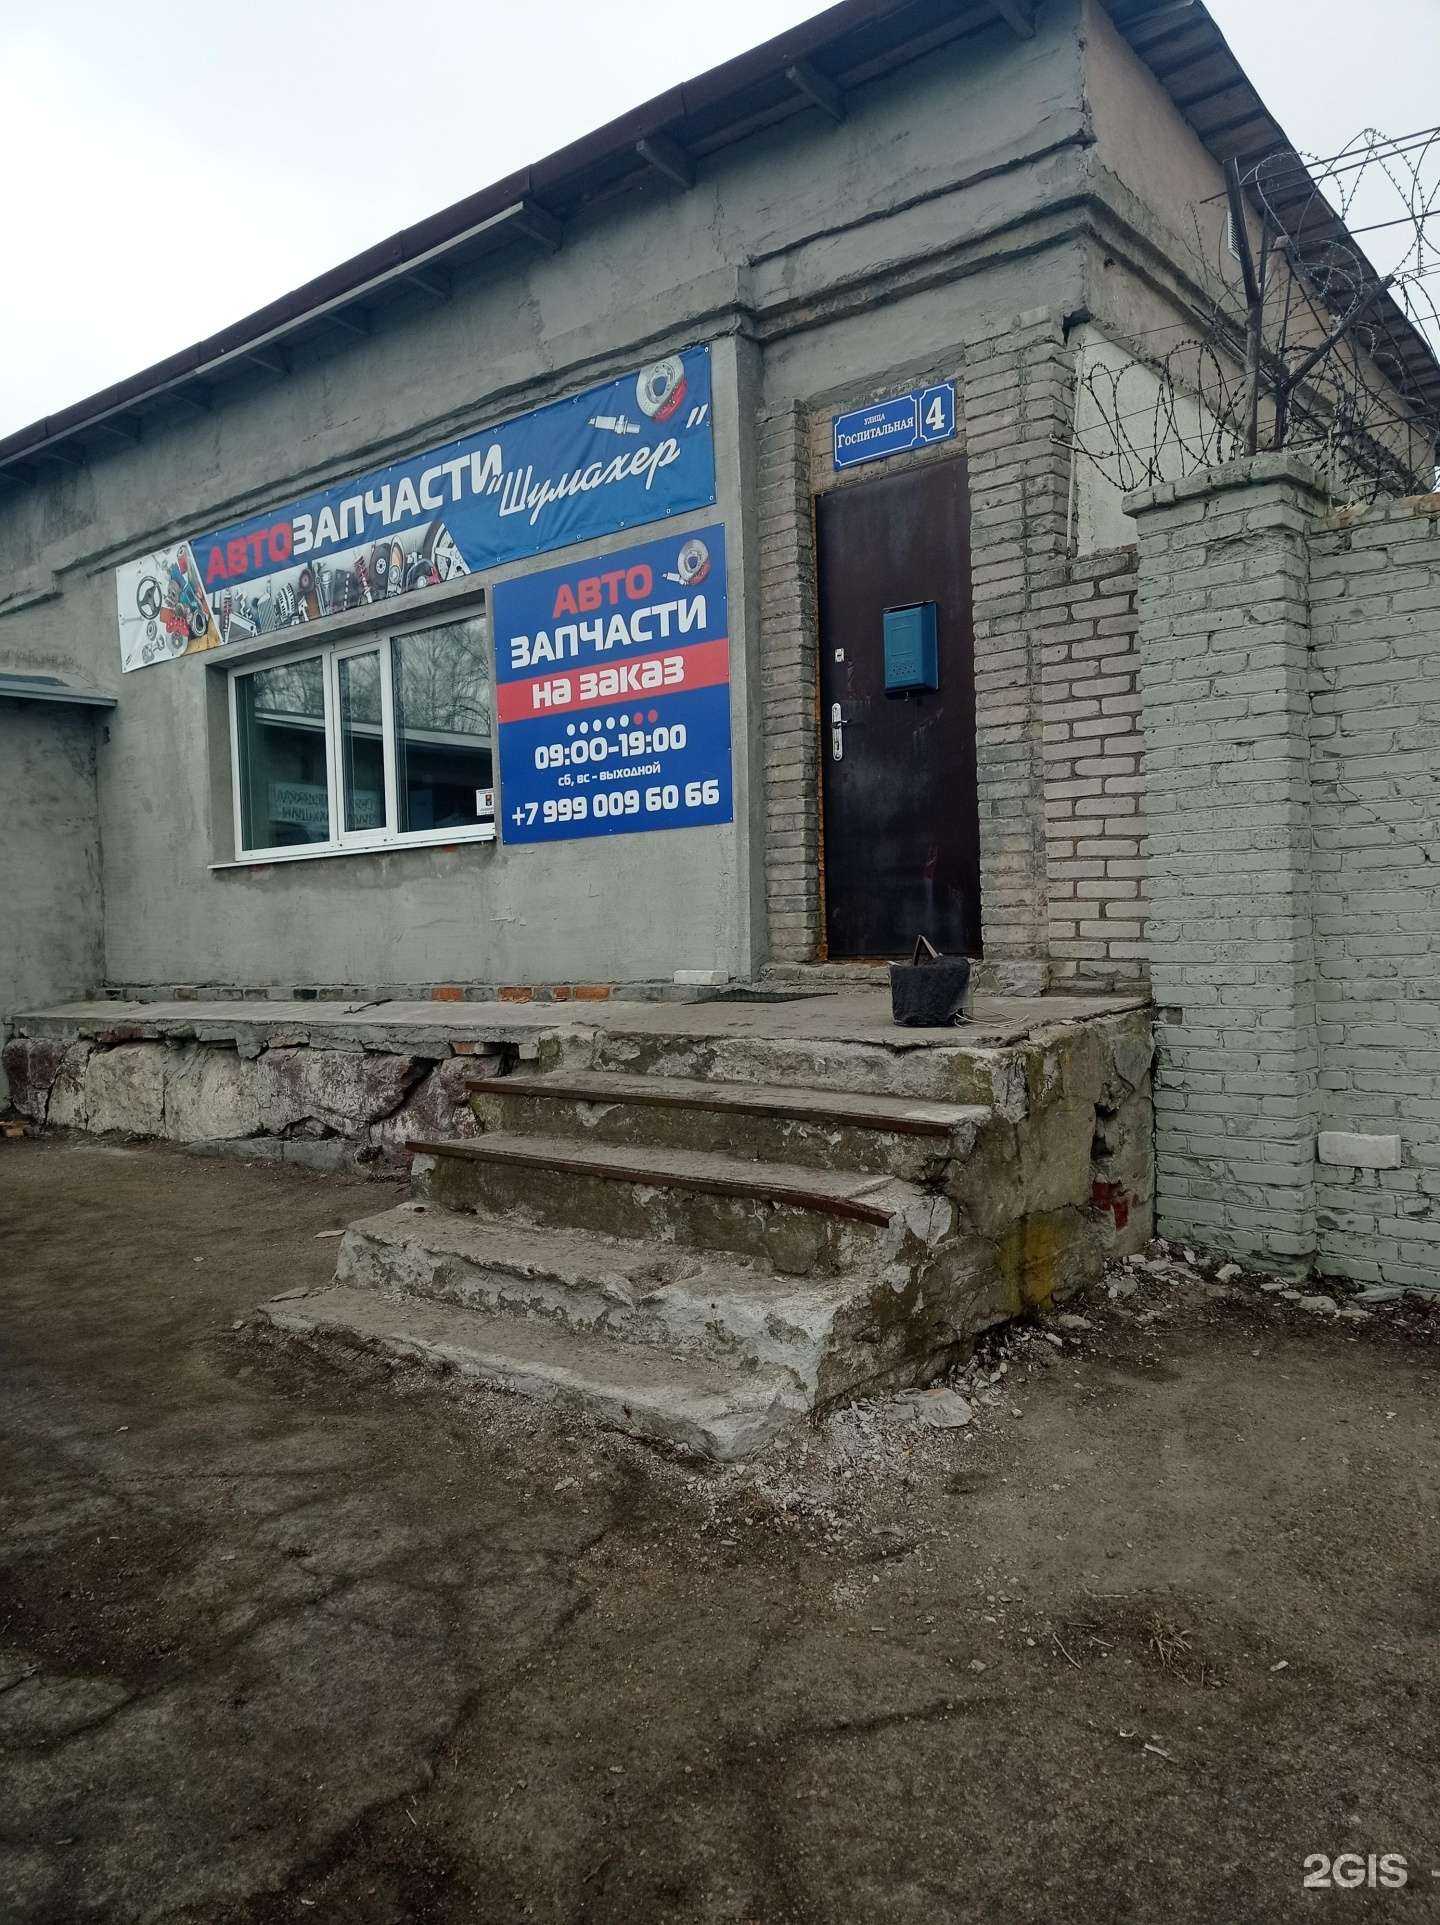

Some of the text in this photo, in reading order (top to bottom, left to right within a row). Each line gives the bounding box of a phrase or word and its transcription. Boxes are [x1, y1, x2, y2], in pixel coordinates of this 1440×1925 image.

[925, 396, 946, 430] 4
[205, 444, 503, 584] АВТОЗАПЧАСТИ
[552, 564, 653, 618] АВТО
[510, 594, 707, 669] ЗАПЧАСТИ
[532, 655, 685, 709] на заказ
[534, 724, 687, 770] 09:00-19:00
[511, 779, 720, 827] +7 999 009 60 66
[577, 773, 590, 785] вс
